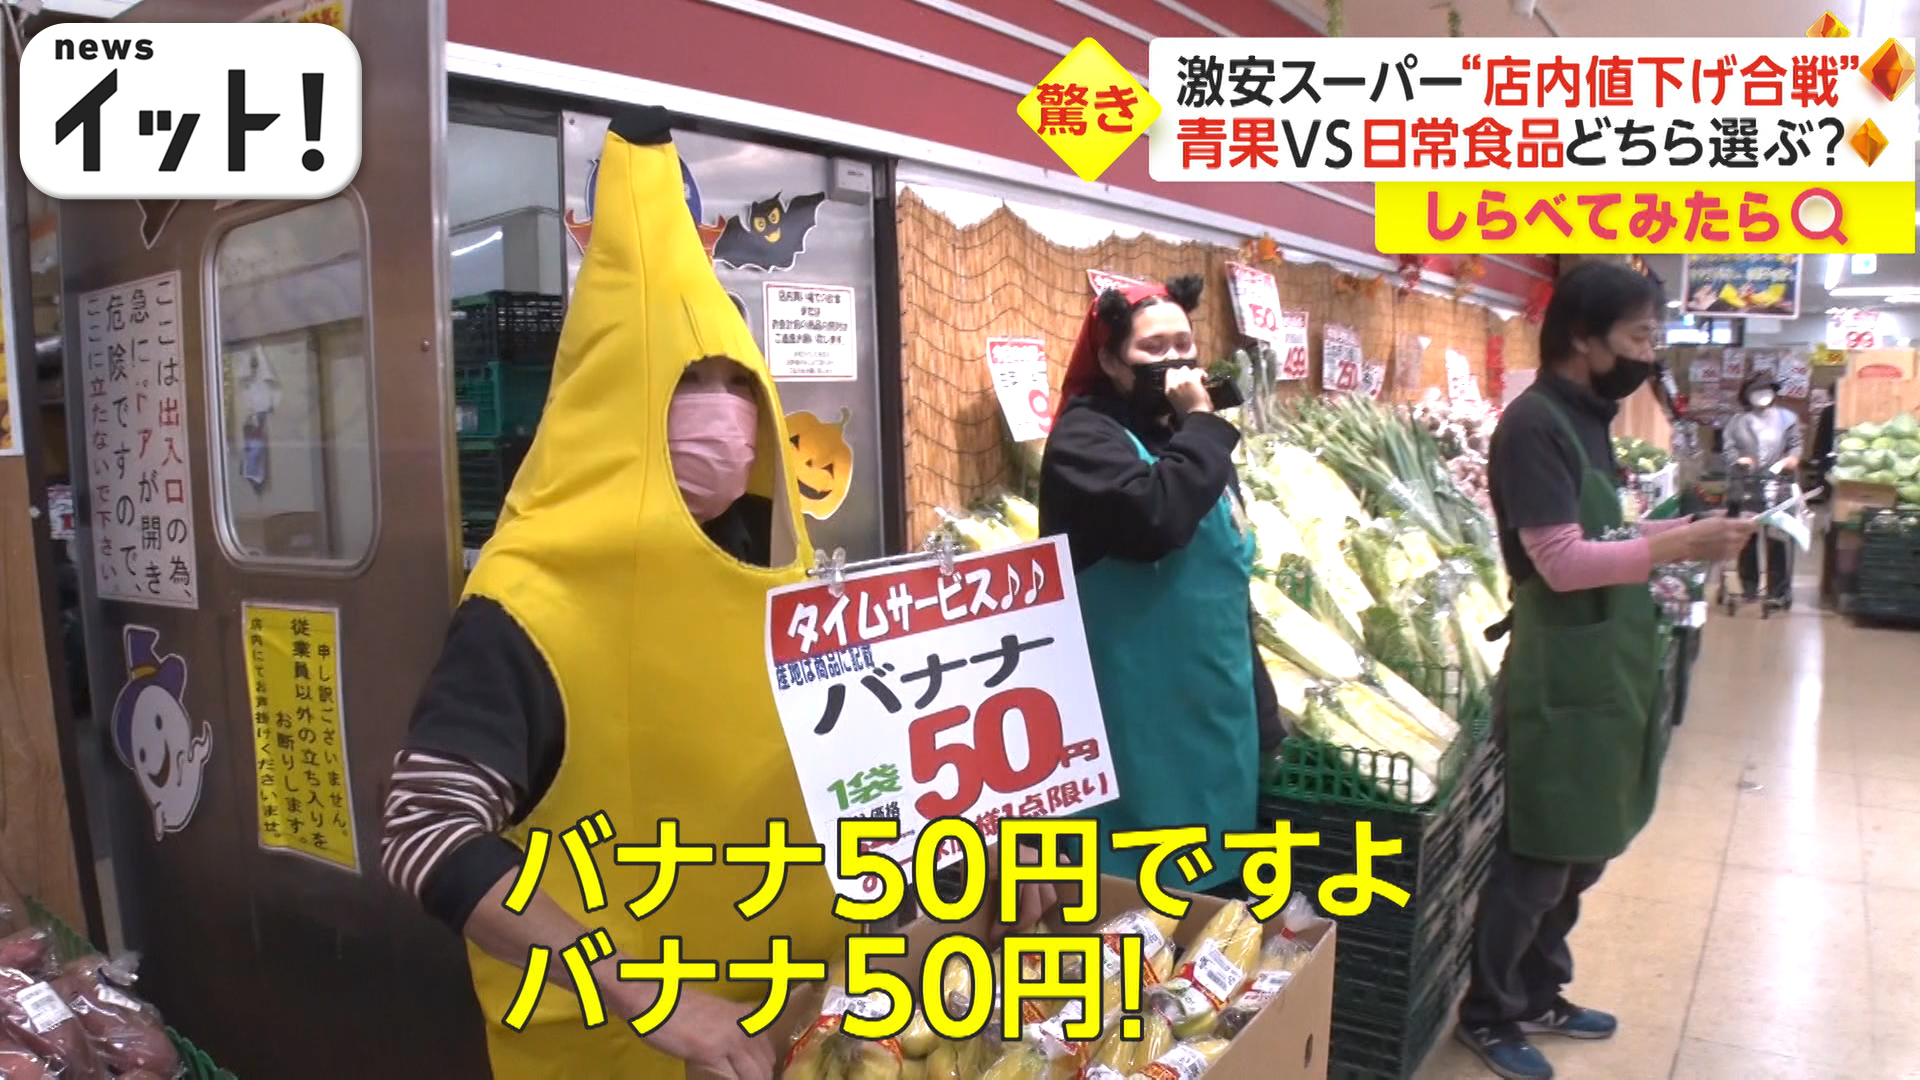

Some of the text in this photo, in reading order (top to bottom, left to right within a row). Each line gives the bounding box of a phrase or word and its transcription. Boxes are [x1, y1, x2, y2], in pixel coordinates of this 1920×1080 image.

[87, 298, 117, 580] ここに立たないで下さい
[106, 295, 142, 592] 危険ですので、
[130, 288, 162, 595] 急にドアが開き
[290, 616, 329, 850] 従業員以外の立ち入りを
[813, 634, 1055, 735] バナナ
[827, 763, 903, 810] 1袋
